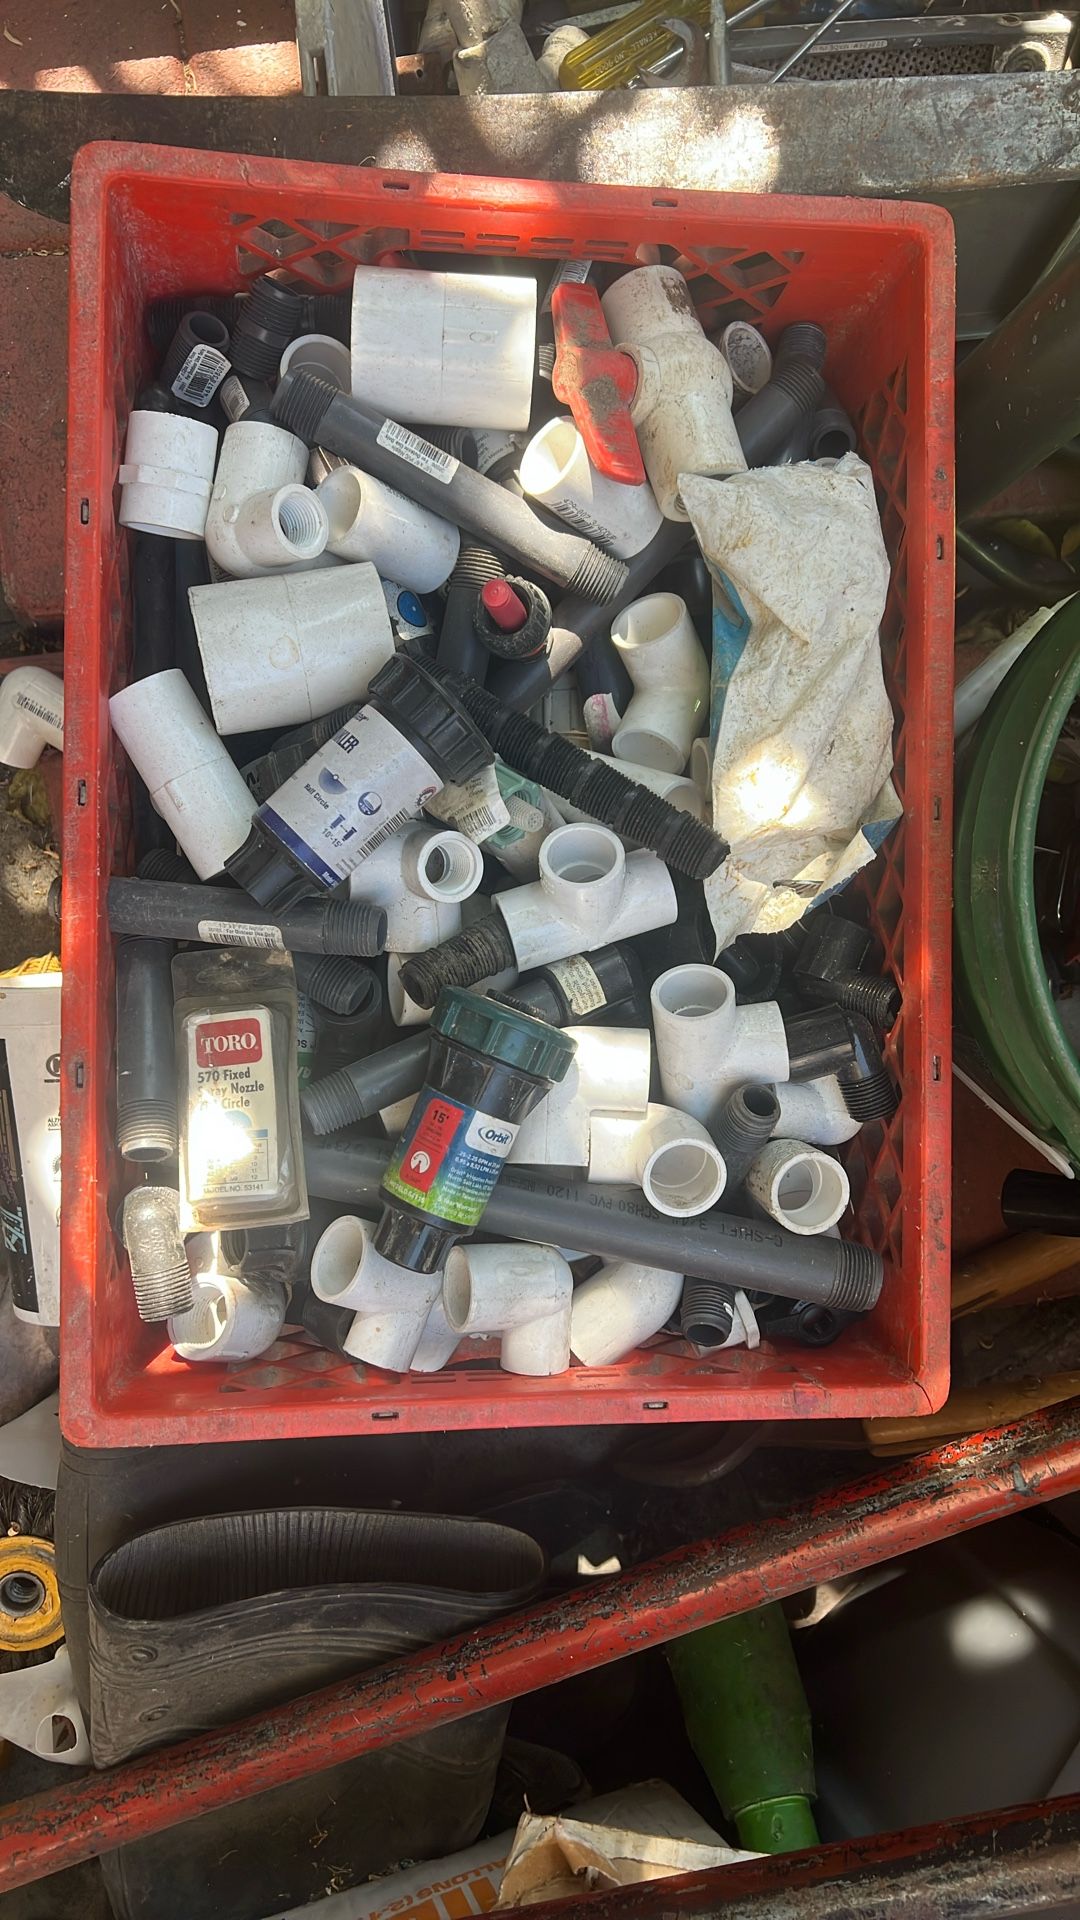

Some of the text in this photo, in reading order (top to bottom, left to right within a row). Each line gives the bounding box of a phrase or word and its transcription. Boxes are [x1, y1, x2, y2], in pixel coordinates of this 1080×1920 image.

[304, 783, 331, 810] Half Circle
[200, 1032, 257, 1054] TORO
[197, 1066, 251, 1084] 570 Fixed
[198, 1080, 265, 1098] Sray Nozzle
[221, 1096, 250, 1109] Circle
[485, 1128, 510, 1146] Orbit
[243, 1183, 264, 1191] 53141
[545, 1185, 579, 1199] 1120
[588, 1193, 614, 1210] PVC
[617, 1199, 662, 1221] SCH80
[718, 1222, 785, 1248] C-SHIFT
[414, 1859, 510, 1900] ALLONS
